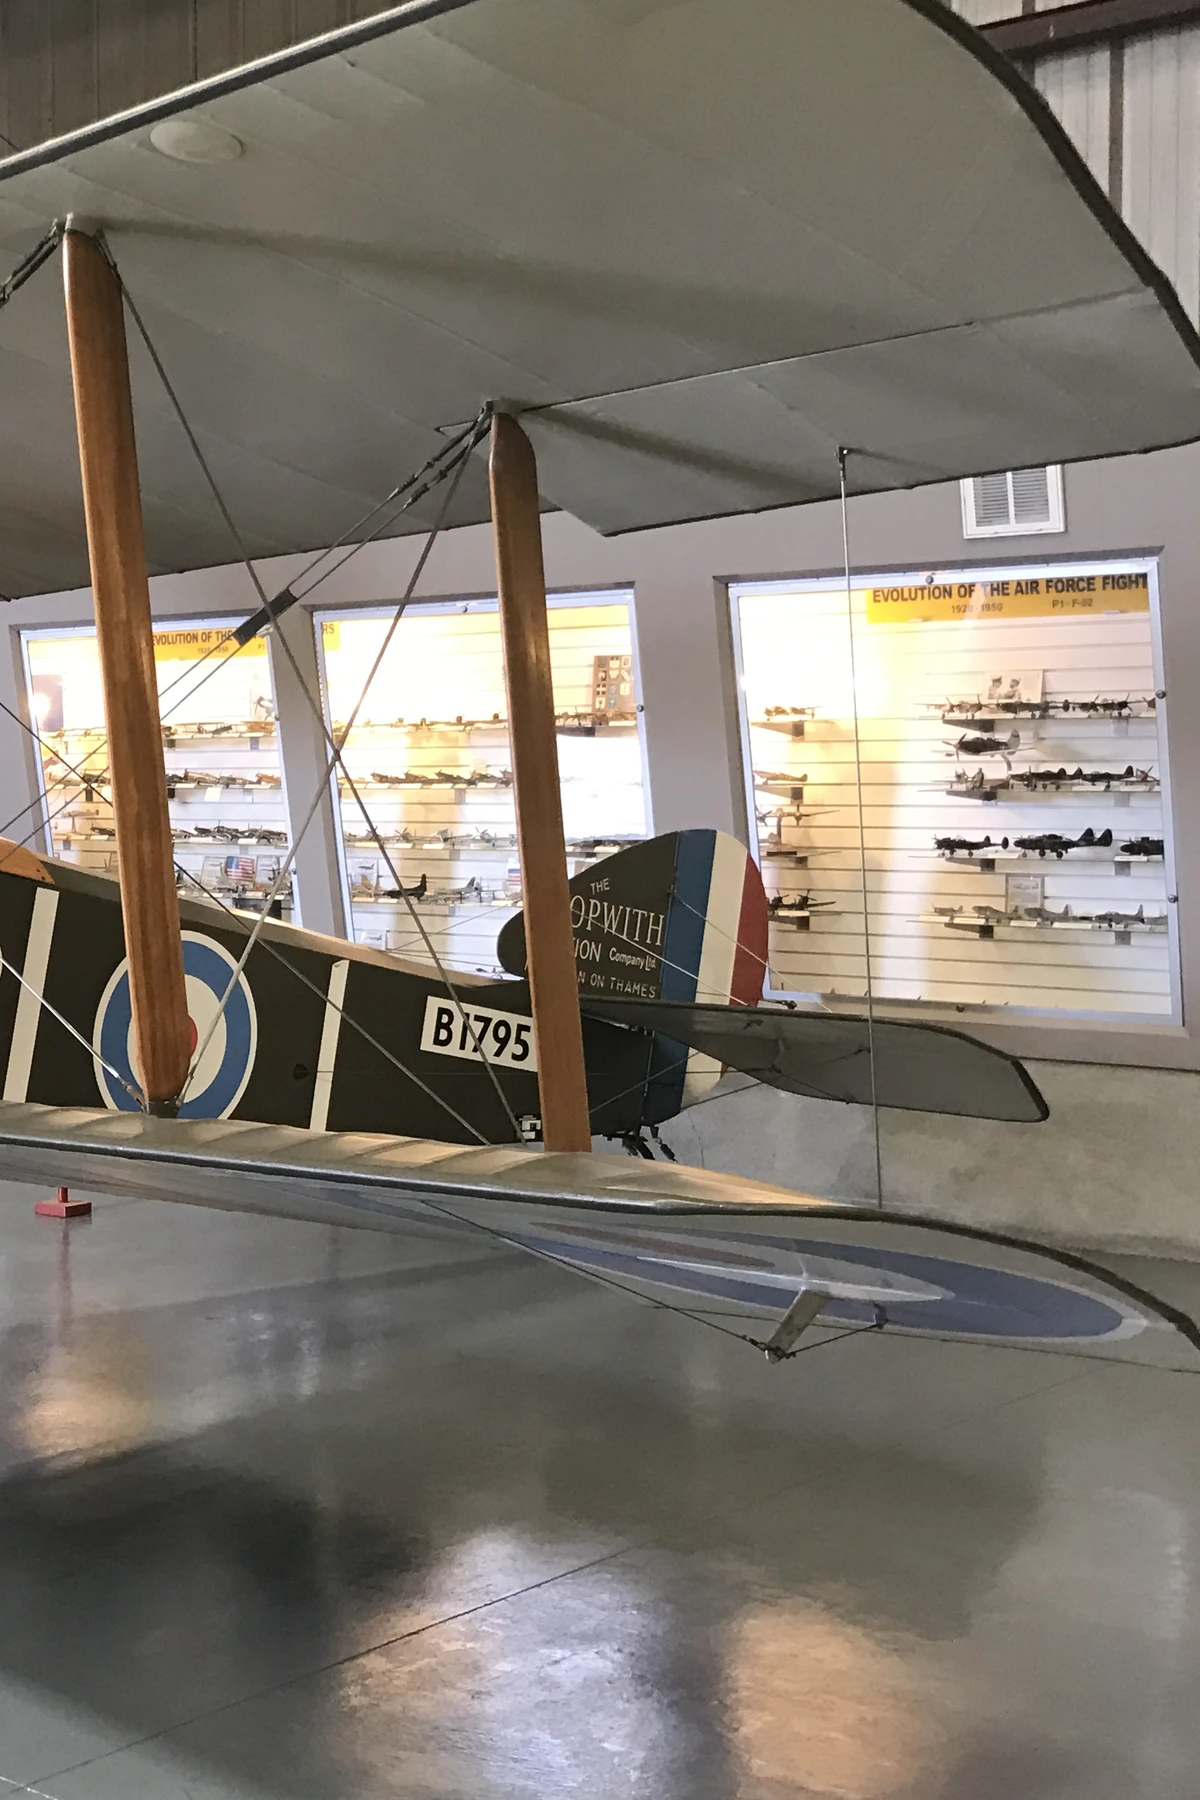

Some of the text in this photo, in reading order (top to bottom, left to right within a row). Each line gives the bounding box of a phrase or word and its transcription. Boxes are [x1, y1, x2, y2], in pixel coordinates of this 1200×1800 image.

[873, 573, 1147, 603] EVOLUTION OF THE AIR FORCE FIGHT
[201, 631, 214, 643] OF
[216, 629, 233, 641] THE
[590, 878, 610, 895] THE
[573, 937, 601, 962] ION
[609, 947, 645, 970] Company
[590, 973, 604, 988] ON
[610, 976, 656, 998] THAMES
[432, 1006, 531, 1062] B1795
